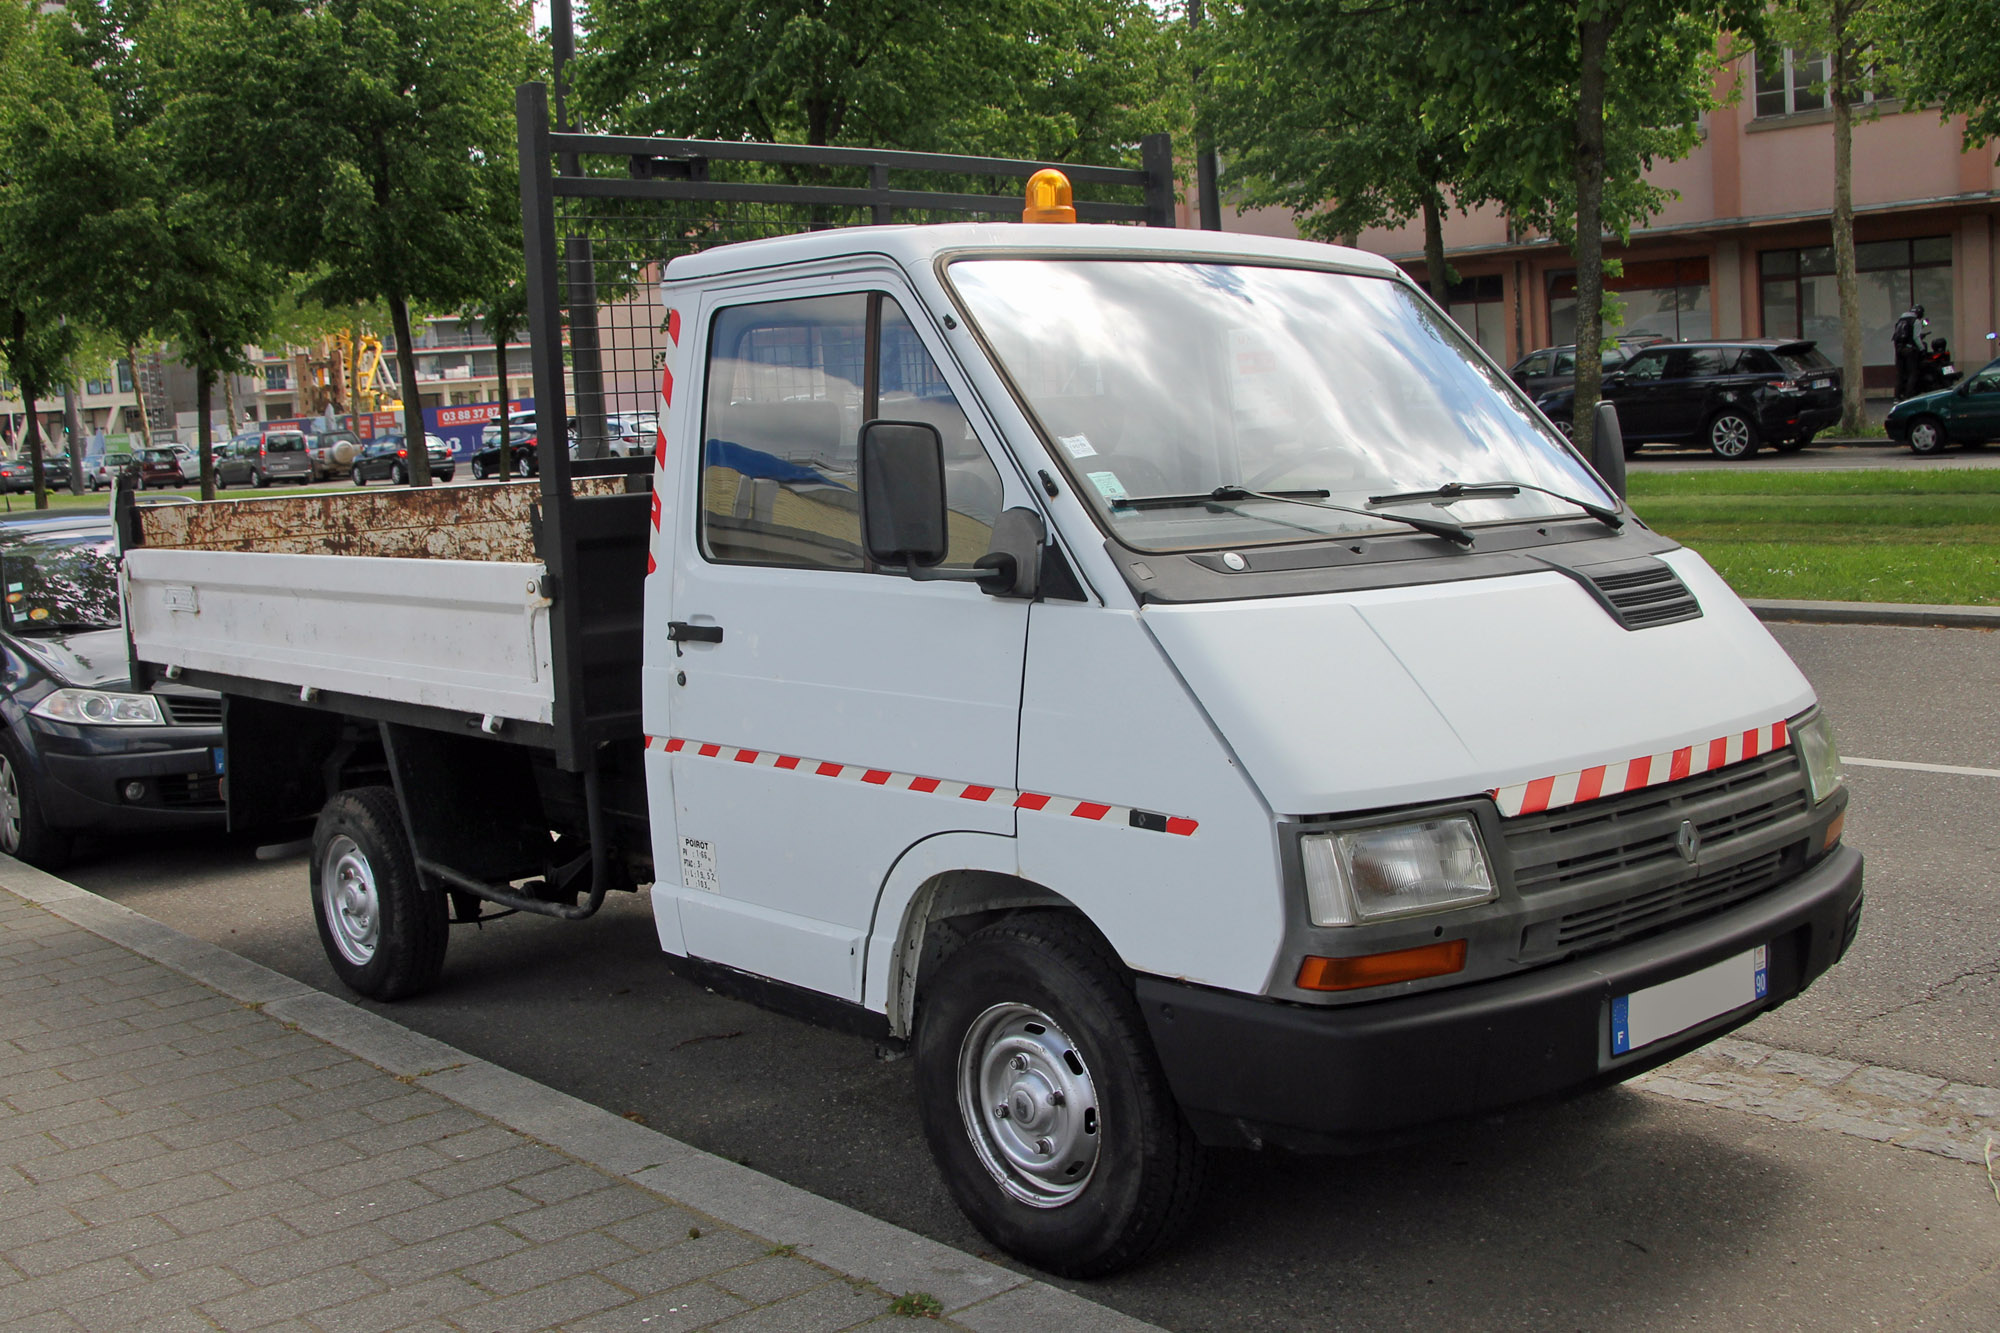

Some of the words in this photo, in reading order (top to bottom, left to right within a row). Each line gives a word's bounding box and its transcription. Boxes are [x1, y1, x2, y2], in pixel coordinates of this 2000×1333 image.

[442, 411, 456, 421] 03
[458, 410, 471, 420] 88
[472, 409, 484, 418] 37
[486, 406, 500, 417] 87
[685, 839, 708, 850] POIROT
[1755, 973, 1766, 993] 90
[1617, 1031, 1624, 1045] F
